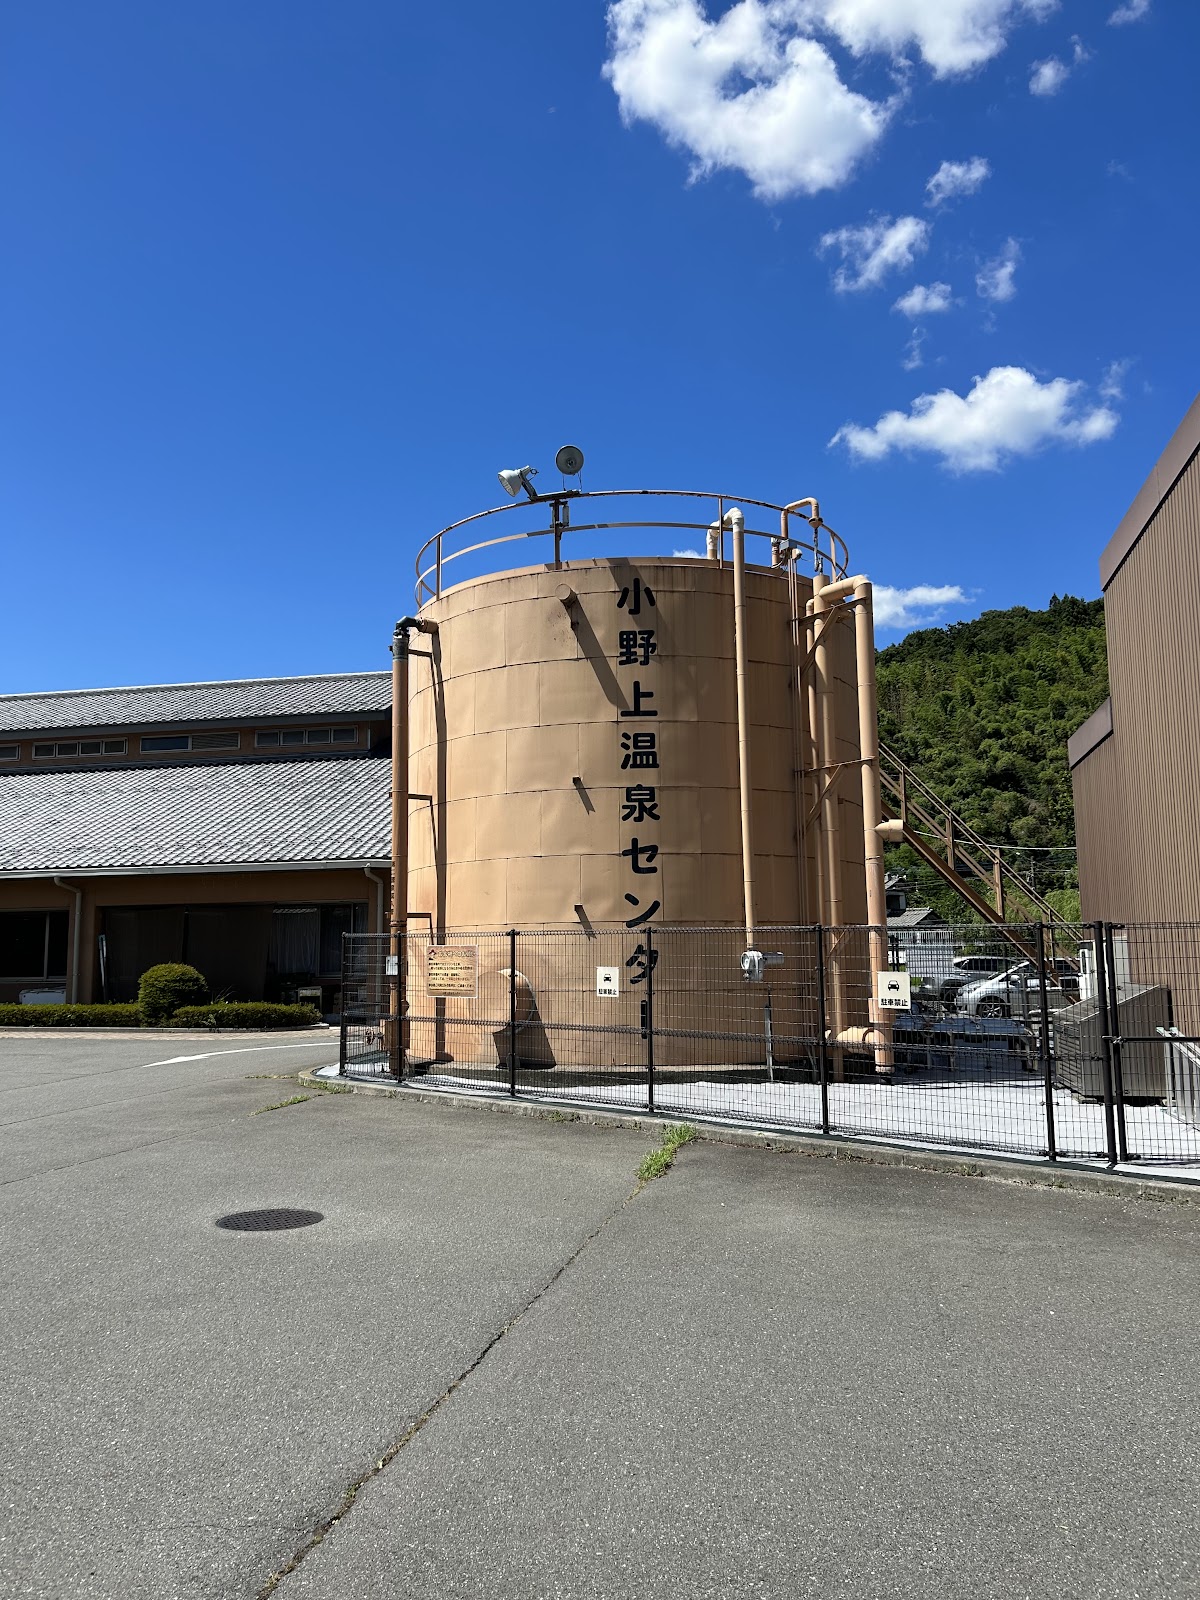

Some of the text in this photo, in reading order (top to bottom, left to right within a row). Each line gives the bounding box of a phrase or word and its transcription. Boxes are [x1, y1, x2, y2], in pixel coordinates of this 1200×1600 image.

[617, 577, 661, 1039] 小野上温泉センター
[880, 998, 909, 1006] 駐車禁止
